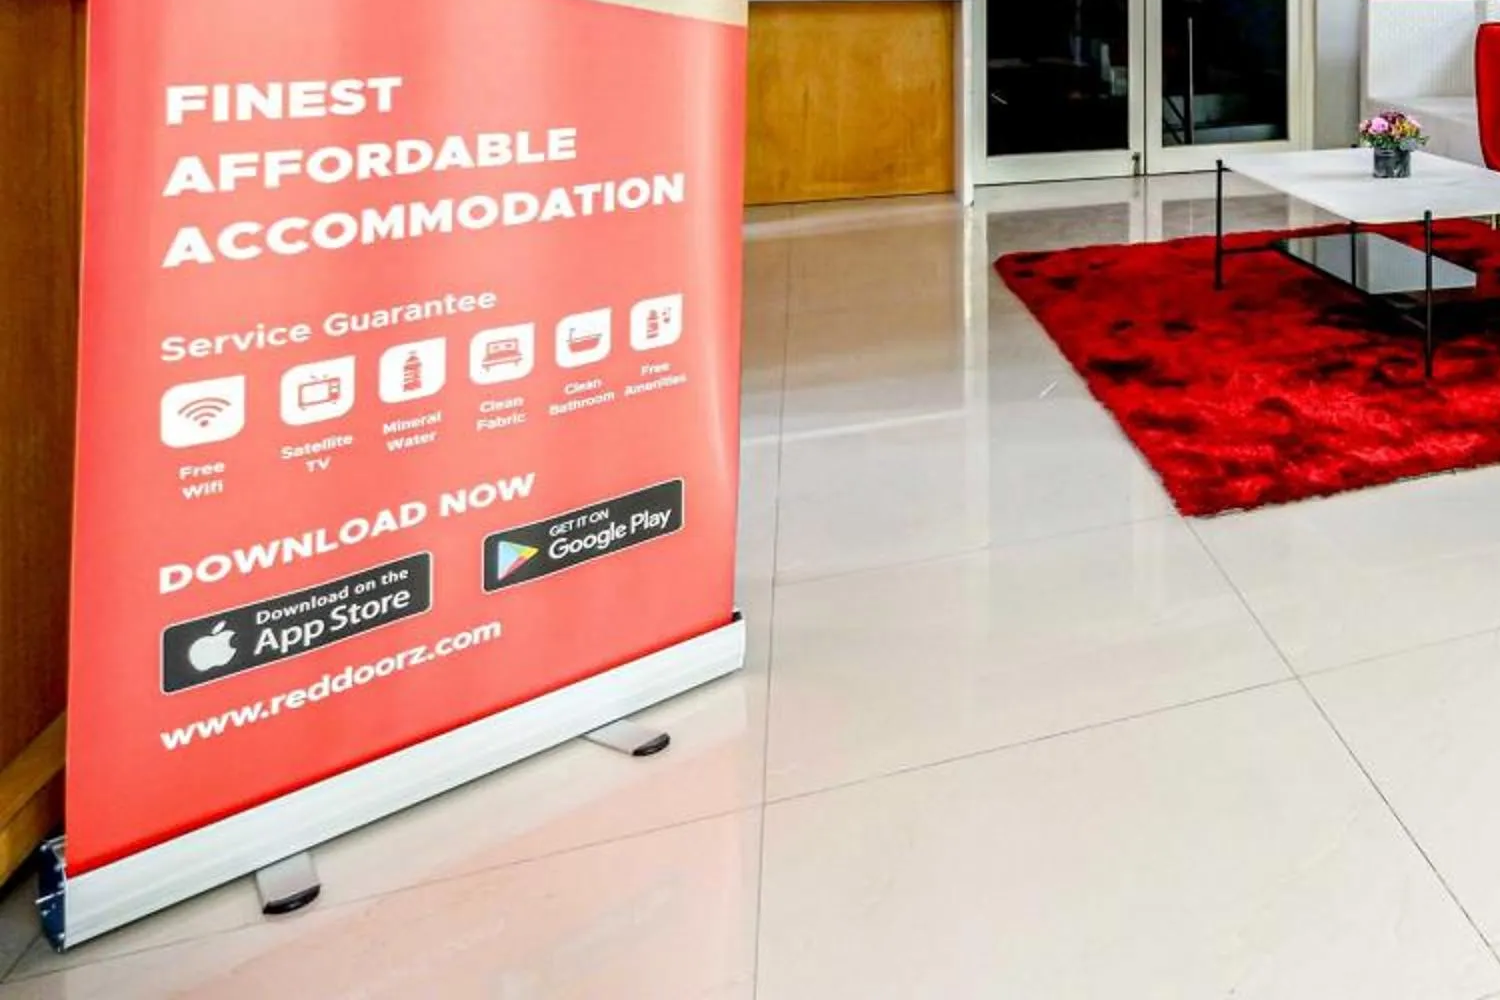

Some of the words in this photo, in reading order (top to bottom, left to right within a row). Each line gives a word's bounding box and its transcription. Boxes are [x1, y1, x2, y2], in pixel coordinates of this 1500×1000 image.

[165, 76, 403, 125] FINEST
[161, 128, 577, 197] AFFORDABLE
[161, 173, 686, 268] ACCOMMODATION
[160, 320, 311, 362] Service
[323, 290, 497, 339] Guarantee
[642, 362, 671, 376] Free
[564, 378, 603, 396] Clean
[479, 396, 525, 414] Clean
[548, 390, 616, 416] Bathroom
[383, 411, 442, 435] Mineral
[476, 412, 527, 431] Fabric
[280, 434, 354, 460] Satellite
[386, 431, 438, 452] Water
[178, 461, 226, 480] Free
[304, 457, 332, 473] TV
[181, 480, 224, 500] Wifi
[159, 501, 427, 595] DOWNLOAD
[439, 472, 536, 518] NOW
[548, 520, 628, 561] Google
[630, 508, 673, 534] Play
[549, 517, 577, 538] GET
[577, 515, 588, 530] IT
[589, 508, 609, 523] ON
[255, 585, 350, 626] Download
[353, 578, 376, 596] on
[381, 567, 409, 587] the
[253, 616, 325, 657] App
[328, 589, 411, 632] Store
[160, 620, 502, 751] www.reddoorz.com
